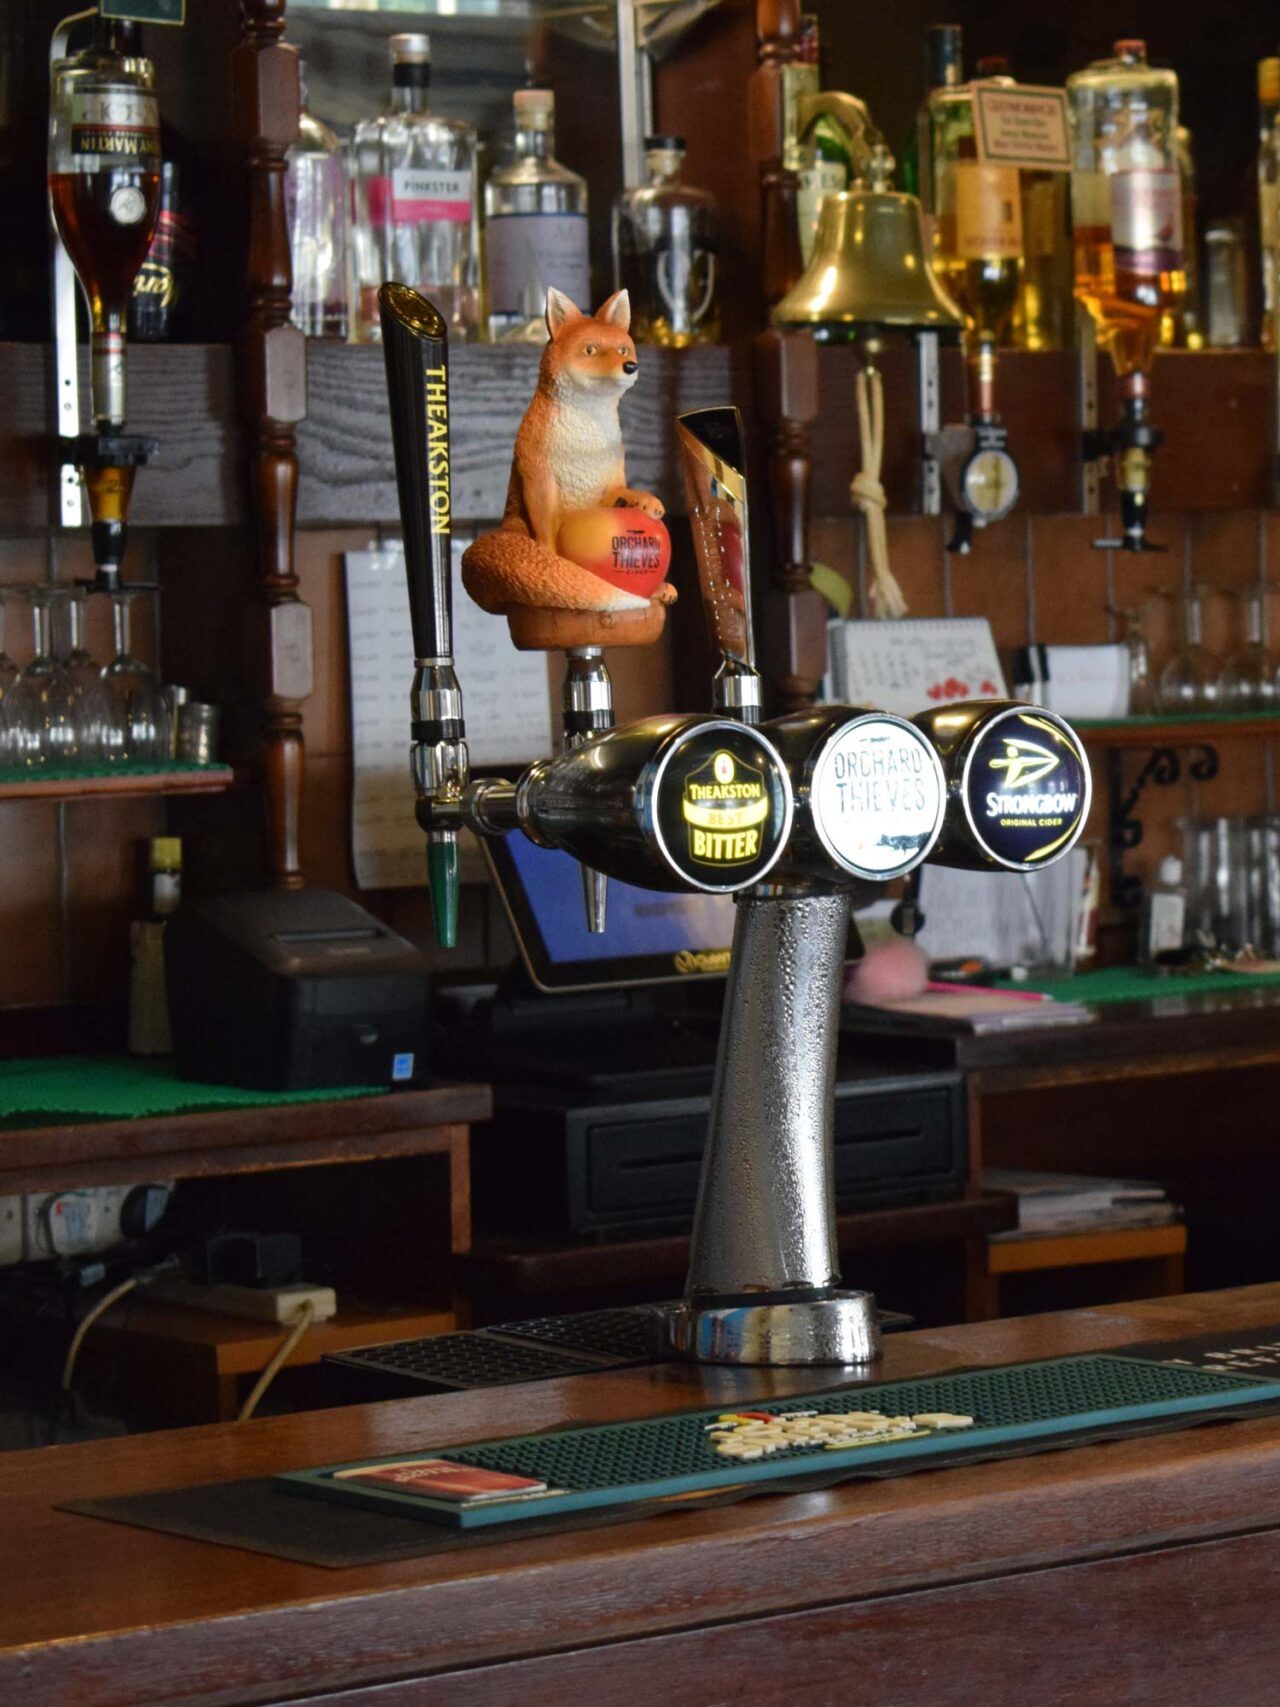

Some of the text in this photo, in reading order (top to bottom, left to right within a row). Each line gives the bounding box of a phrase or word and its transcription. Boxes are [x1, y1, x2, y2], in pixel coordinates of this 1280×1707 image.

[404, 181, 460, 193] PINKSTER
[425, 364, 451, 535] THEAKSTON
[612, 536, 661, 551] ORCHARD
[612, 551, 660, 569] THIEVES
[835, 748, 923, 779] ORCHARD
[689, 783, 761, 800] THEAKSTON
[836, 778, 925, 813] THIEVES
[986, 792, 1077, 817] STRONGBOW
[708, 811, 744, 825] BEST
[1000, 818, 1063, 827] ORIGINAL CIDER
[693, 828, 758, 860] BITTER
